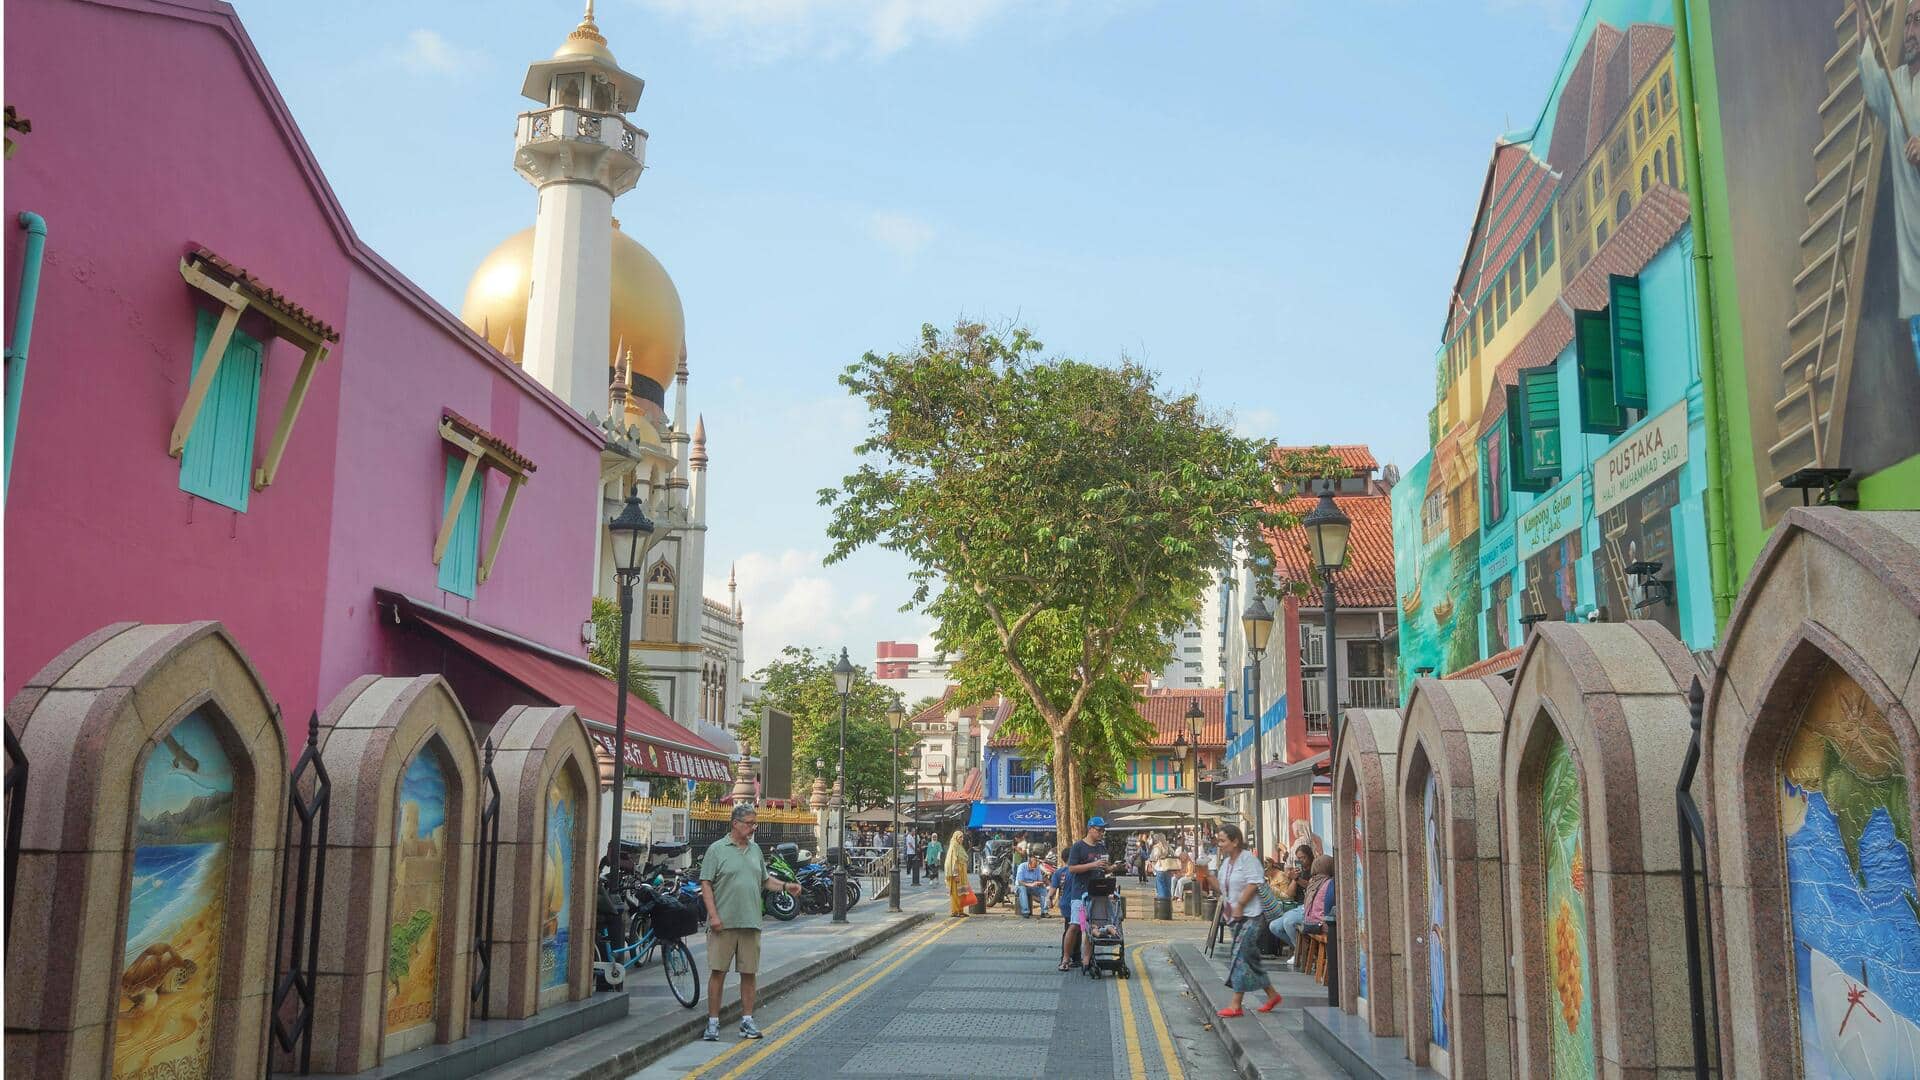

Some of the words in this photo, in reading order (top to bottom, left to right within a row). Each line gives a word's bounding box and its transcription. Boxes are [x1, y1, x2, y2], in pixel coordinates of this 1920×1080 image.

[1602, 483, 1616, 502] HAJI
[1619, 457, 1658, 490] MUHAMMAD
[1662, 444, 1679, 465] SAID
[1609, 427, 1664, 481] PUSTAKA
[1523, 508, 1550, 534] Kampong
